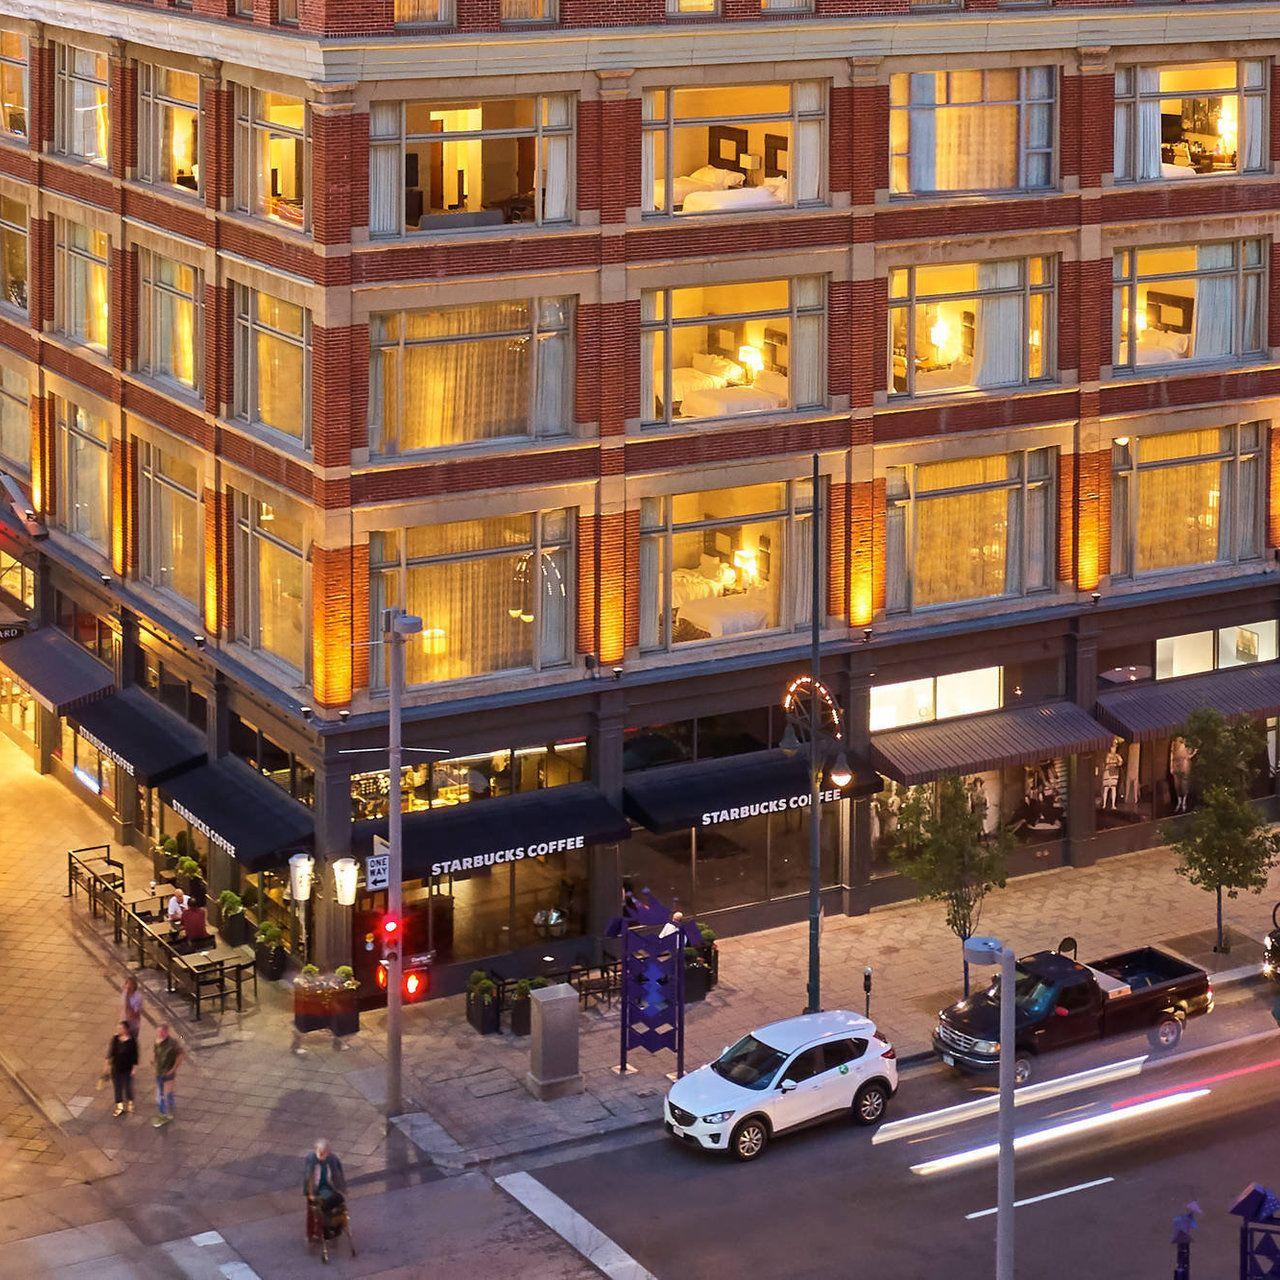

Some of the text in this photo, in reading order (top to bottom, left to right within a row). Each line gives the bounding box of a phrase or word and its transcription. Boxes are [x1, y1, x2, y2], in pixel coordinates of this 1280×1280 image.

[80, 725, 134, 776] STARBUCKS COFFEE
[172, 799, 235, 858] STARBUCKS COFFEE
[702, 799, 787, 825] STARBUCKS
[370, 858, 387, 867] ONE
[431, 835, 585, 875] STARBUCKS COFFEE
[370, 868, 387, 876] WAY
